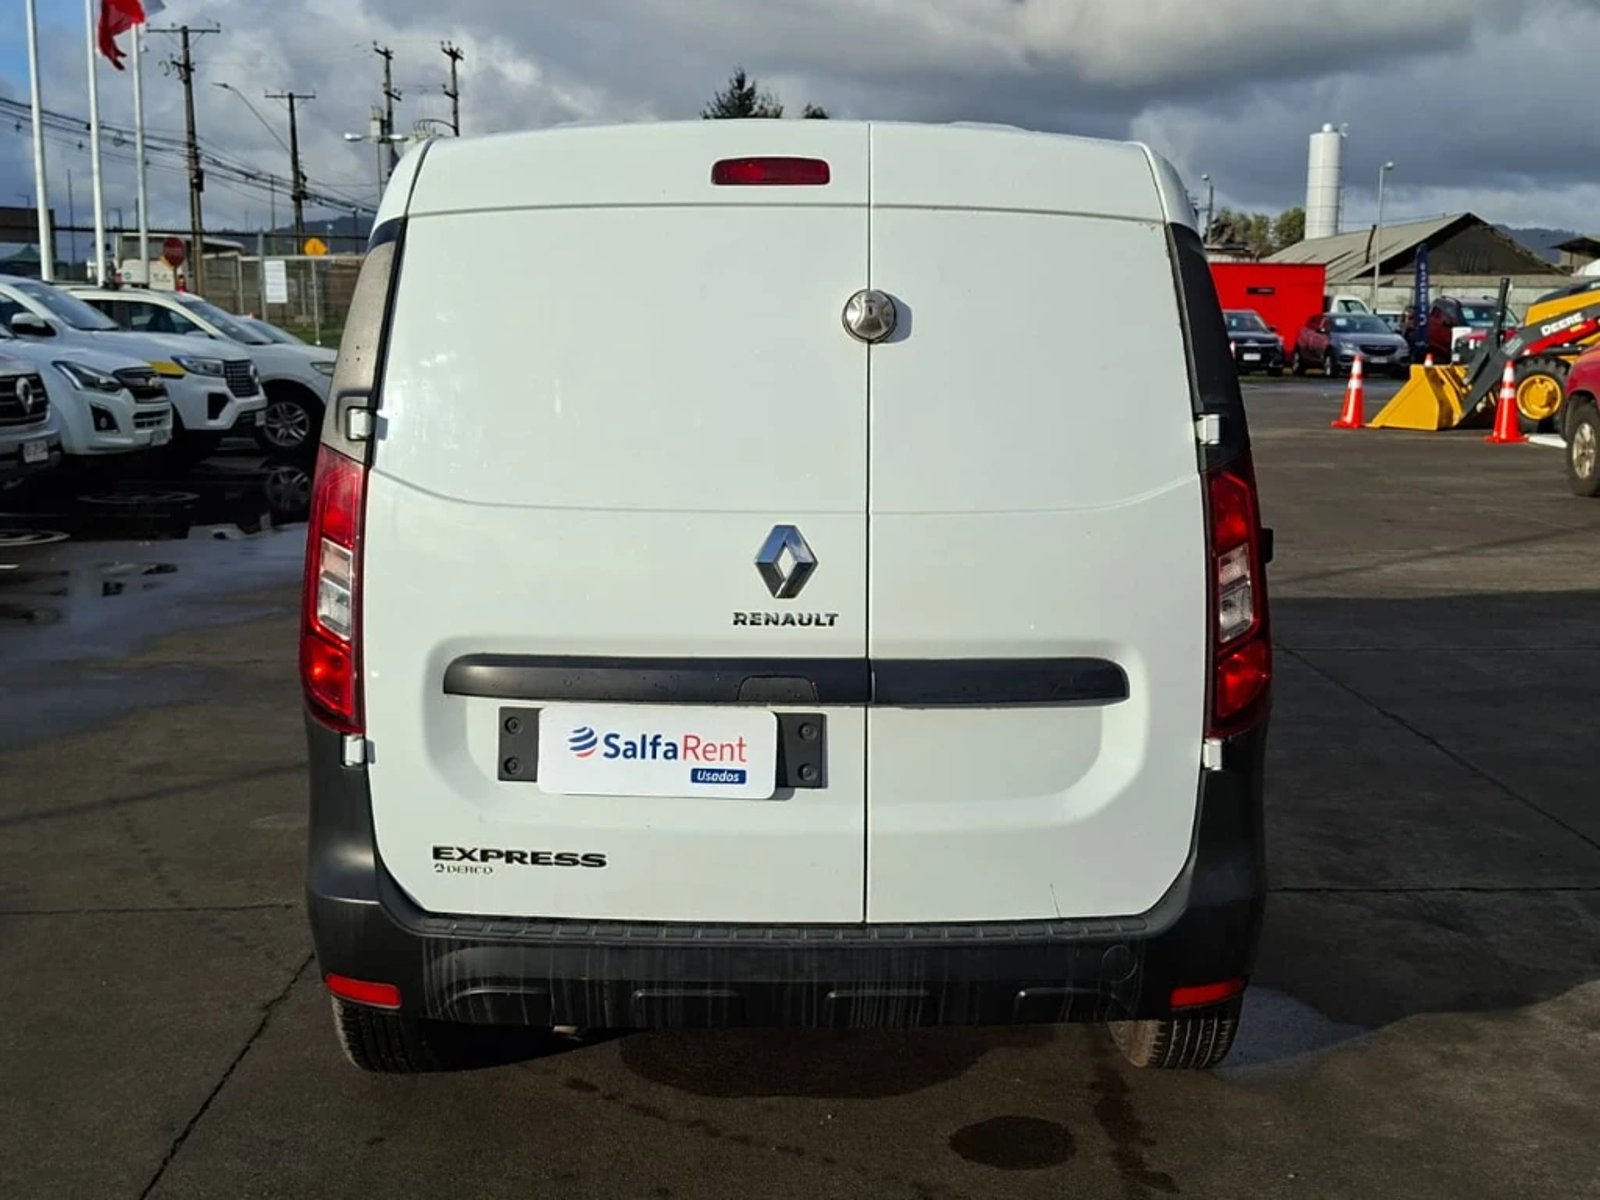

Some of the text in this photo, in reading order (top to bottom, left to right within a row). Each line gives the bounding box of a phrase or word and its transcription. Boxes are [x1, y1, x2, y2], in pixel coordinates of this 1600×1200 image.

[1541, 312, 1584, 336] DEERE
[733, 612, 839, 626] RENAULT
[697, 770, 739, 782] Usados
[432, 846, 607, 868] EXPRESS
